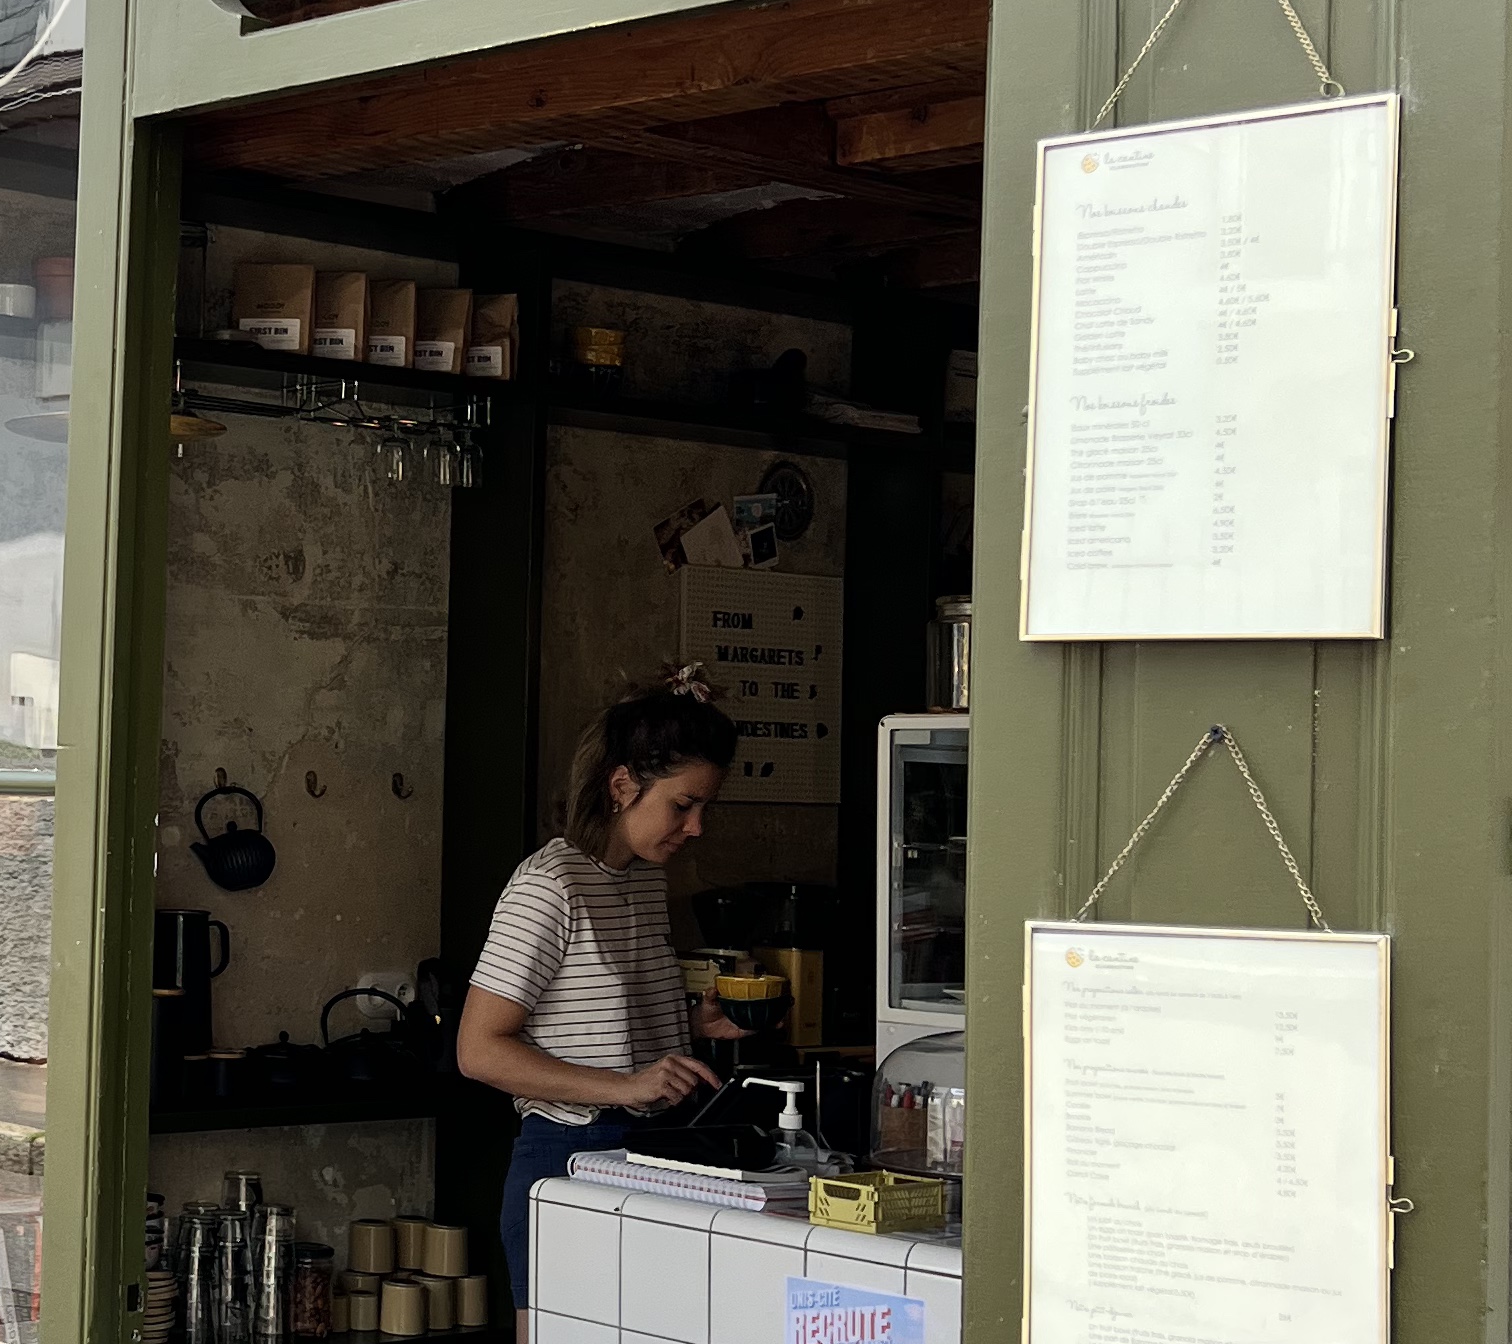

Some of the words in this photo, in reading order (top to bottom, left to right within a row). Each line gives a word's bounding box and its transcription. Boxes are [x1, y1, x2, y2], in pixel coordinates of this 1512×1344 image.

[711, 610, 754, 630] FROM
[715, 644, 805, 667] MARGARETS
[739, 679, 760, 698] TO
[770, 681, 801, 700] THE
